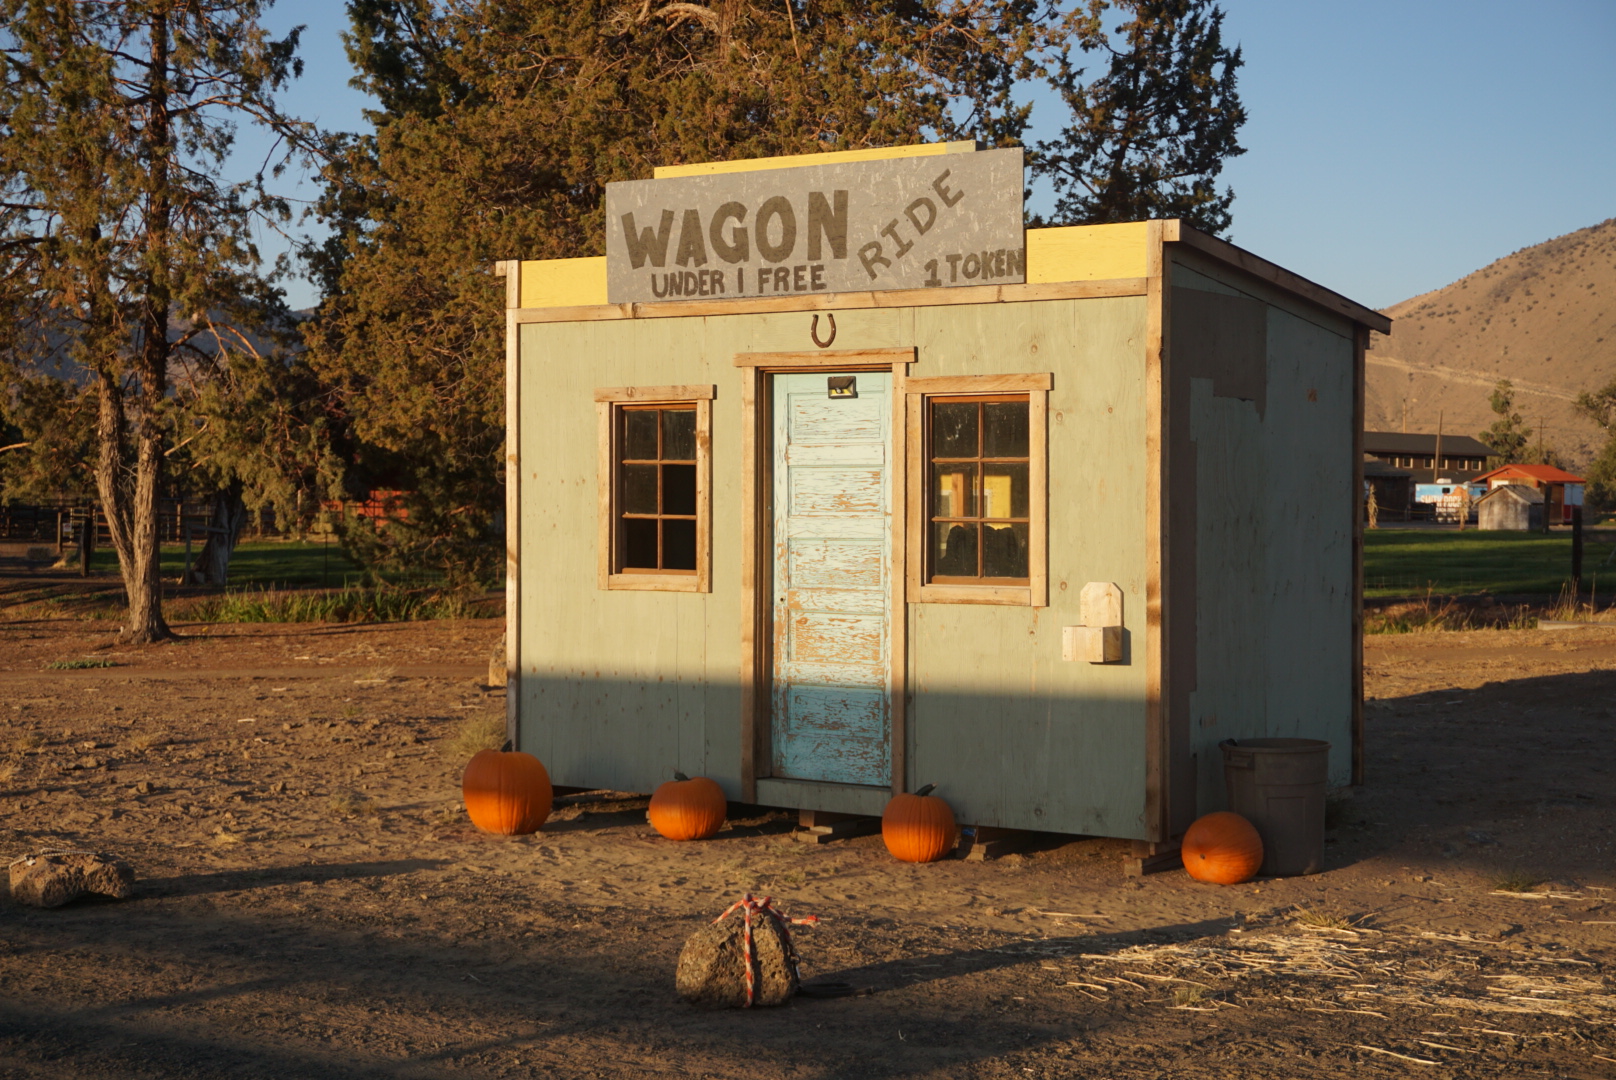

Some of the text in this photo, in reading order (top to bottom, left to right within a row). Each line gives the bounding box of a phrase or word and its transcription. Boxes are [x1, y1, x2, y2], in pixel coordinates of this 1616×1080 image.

[621, 168, 965, 281] WAGON RIDE
[651, 269, 725, 298] UNDER
[758, 264, 827, 295] FREE
[924, 248, 1025, 288] 1 TOKEN
